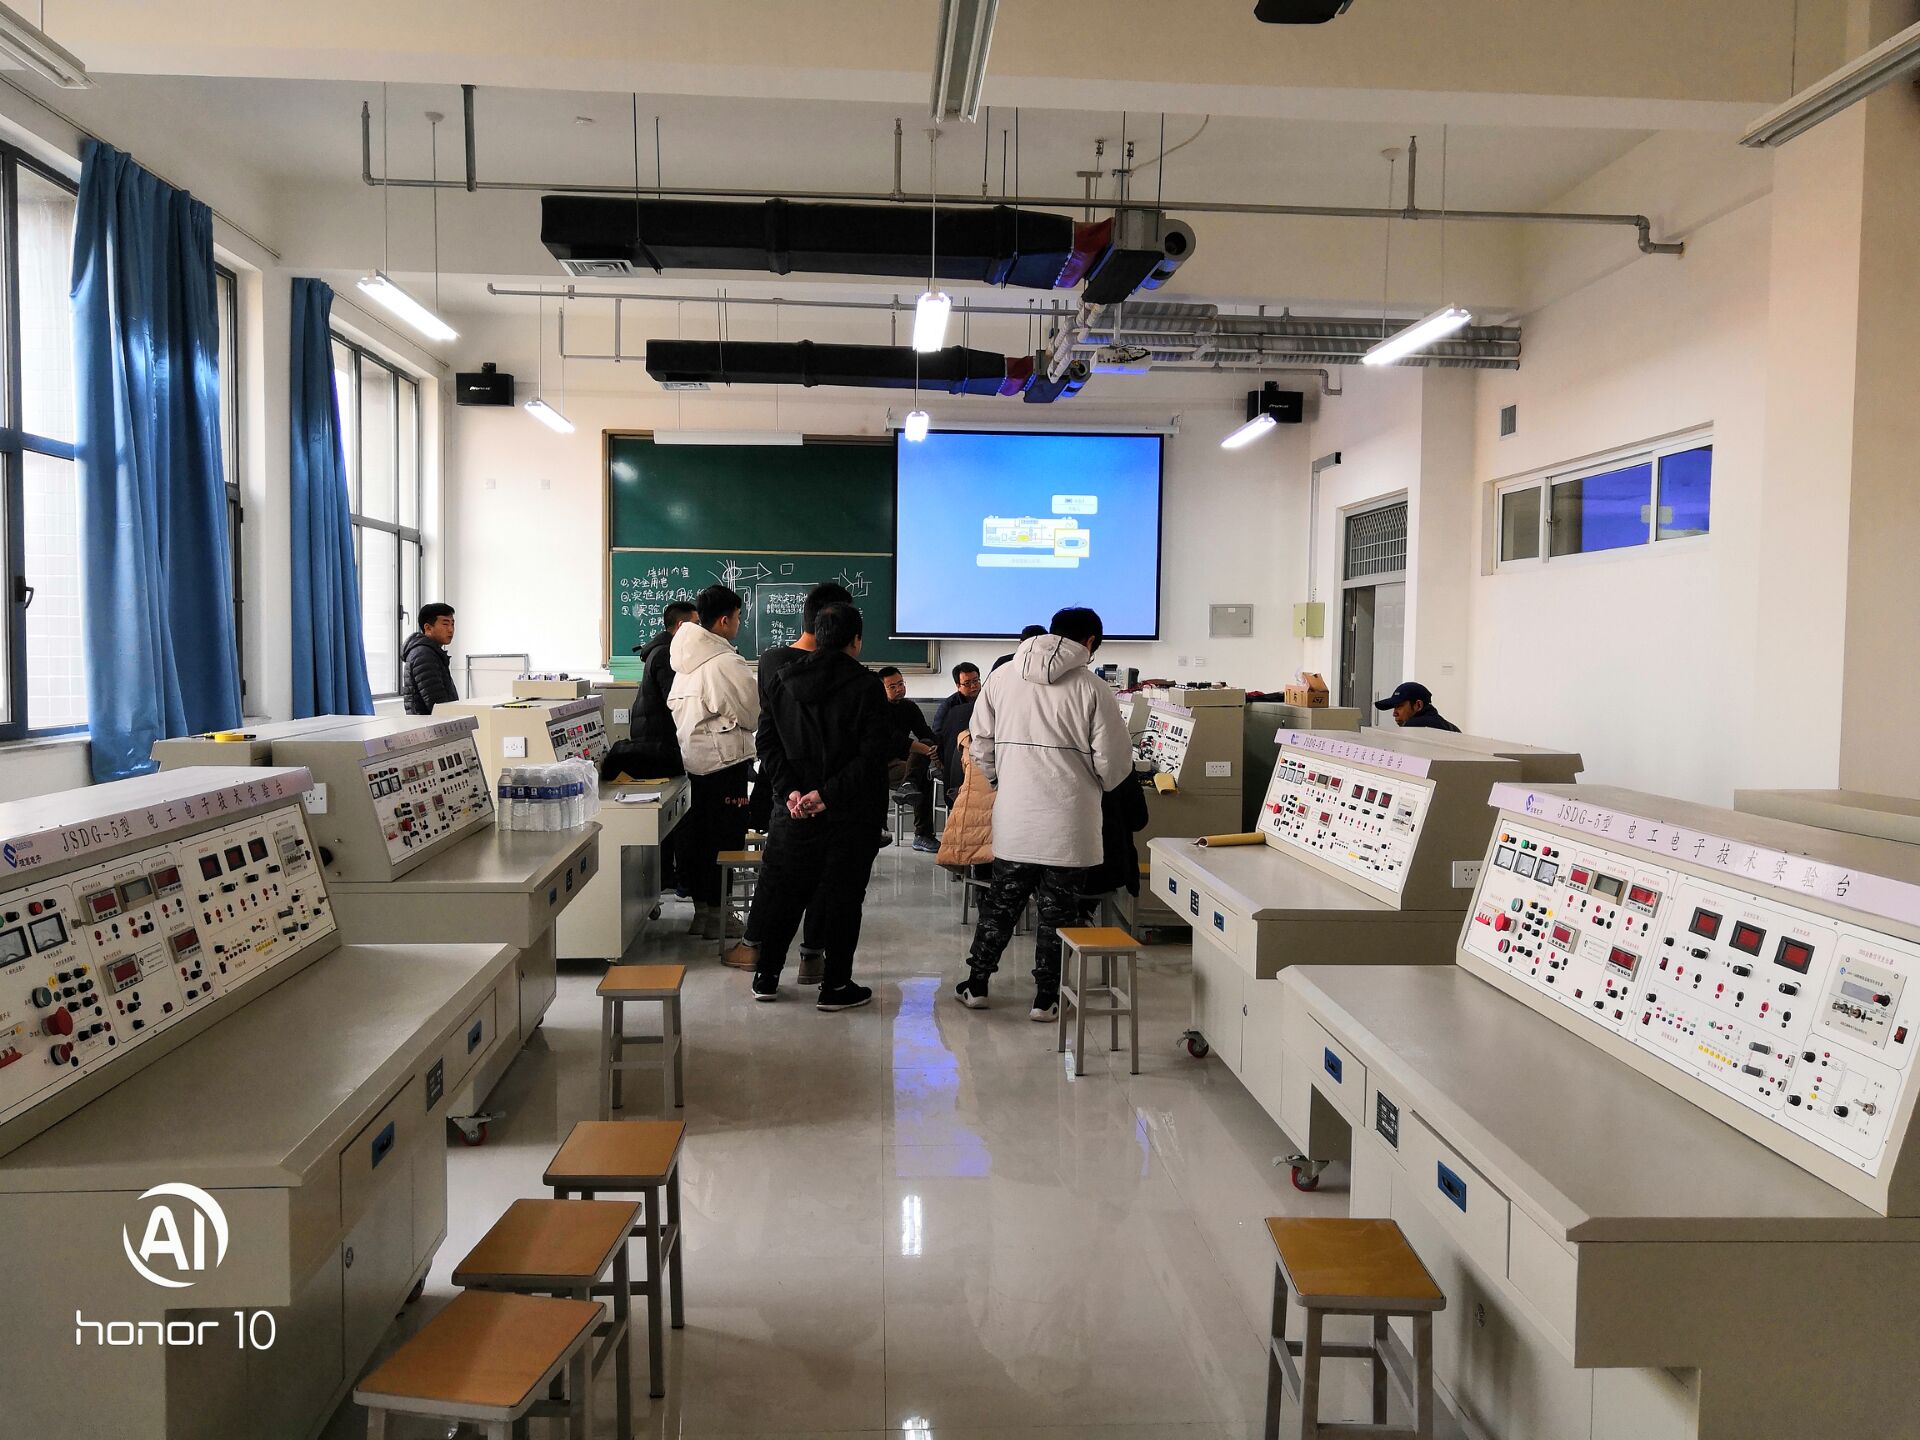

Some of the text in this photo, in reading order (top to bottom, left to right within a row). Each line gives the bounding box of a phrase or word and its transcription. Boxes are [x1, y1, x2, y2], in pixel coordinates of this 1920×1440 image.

[62, 780, 284, 853] JSDG-5型 电工电子技术实验台
[1557, 803, 1850, 897] JSDG-5型 电工电子技术实验台
